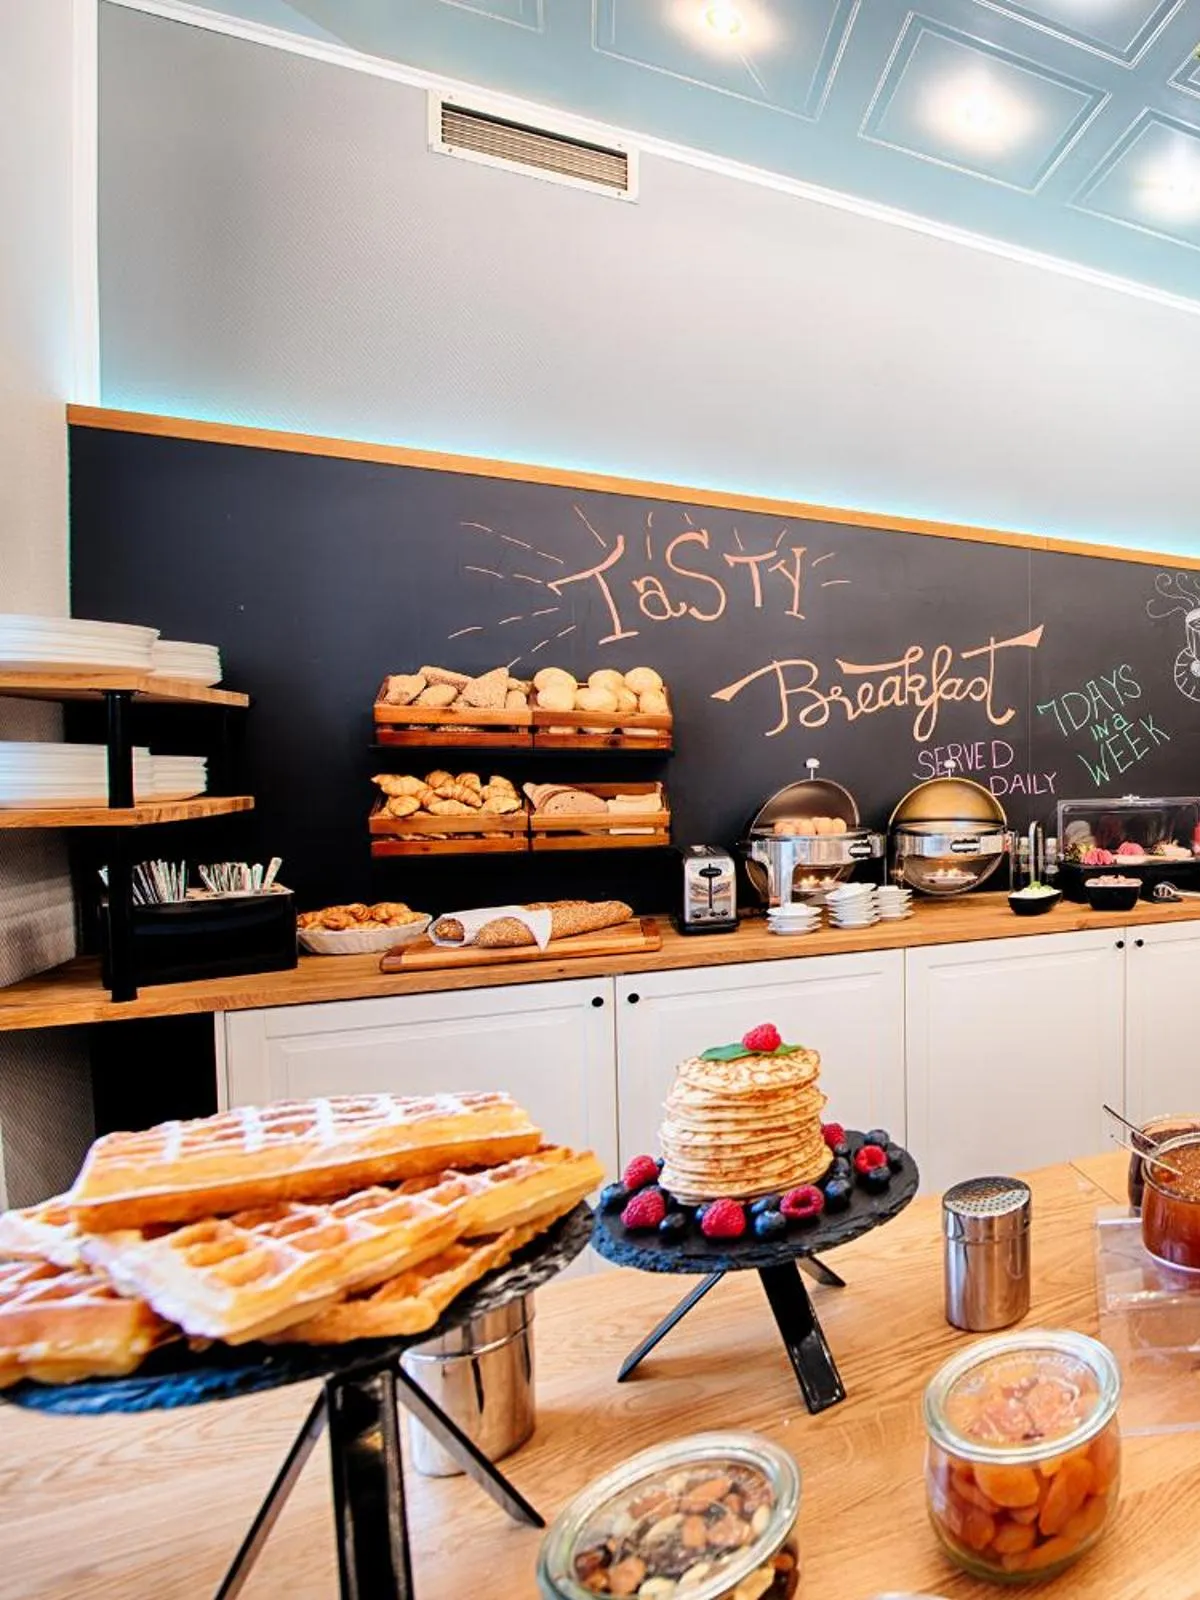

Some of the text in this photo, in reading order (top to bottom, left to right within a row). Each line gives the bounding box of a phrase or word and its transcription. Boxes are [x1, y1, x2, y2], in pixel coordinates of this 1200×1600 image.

[710, 624, 1045, 741] Breakfast
[912, 740, 1014, 780] SERVED
[1077, 714, 1171, 787] WEEK
[989, 771, 1057, 796] DAILY
